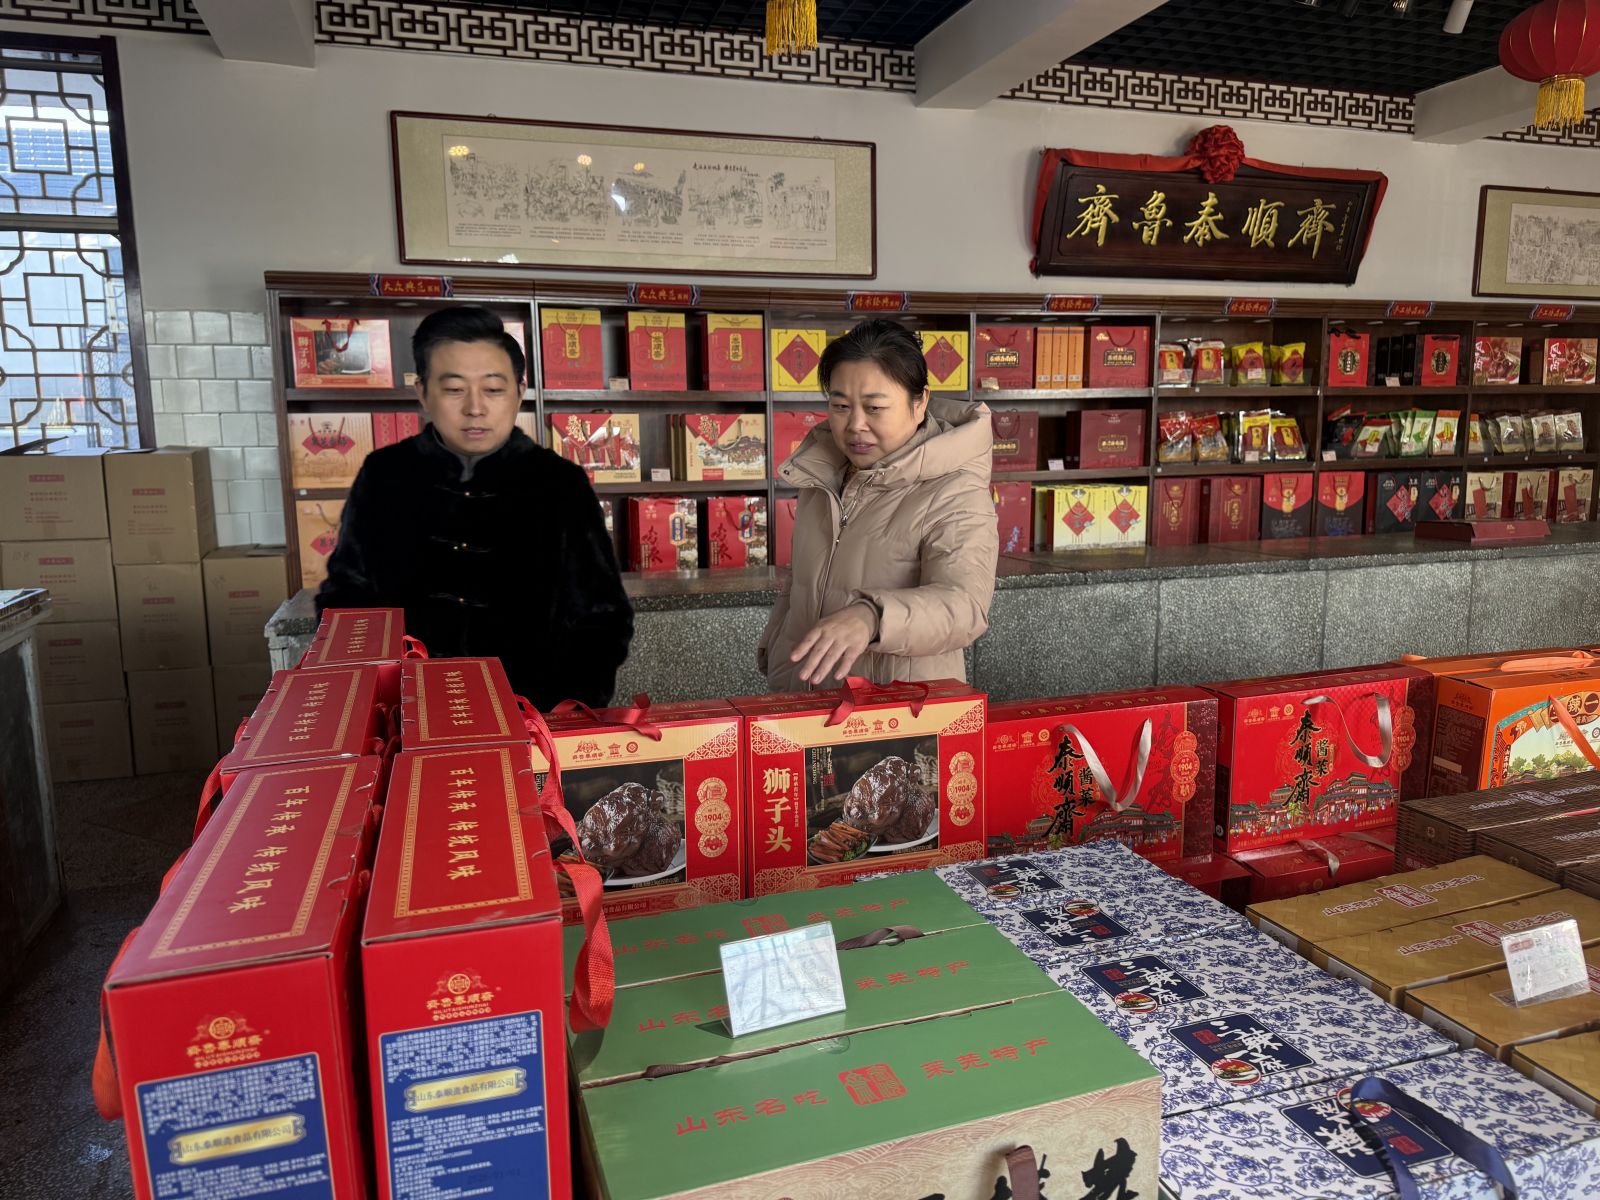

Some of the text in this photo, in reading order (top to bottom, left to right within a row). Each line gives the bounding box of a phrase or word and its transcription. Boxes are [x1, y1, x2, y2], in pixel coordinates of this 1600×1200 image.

[1397, 735, 1410, 743] 1904
[1178, 762, 1193, 771] 1904
[954, 785, 970, 793] 1904
[446, 767, 483, 880] 百年传承 传统风味
[703, 813, 723, 822] 1904
[762, 767, 793, 854] 狮子头
[227, 786, 310, 914] 百年传承 传统风味
[855, 960, 971, 991] 莱芜特产
[920, 1037, 1050, 1080] 莱芜特产
[674, 1089, 830, 1137] 山东名吃
